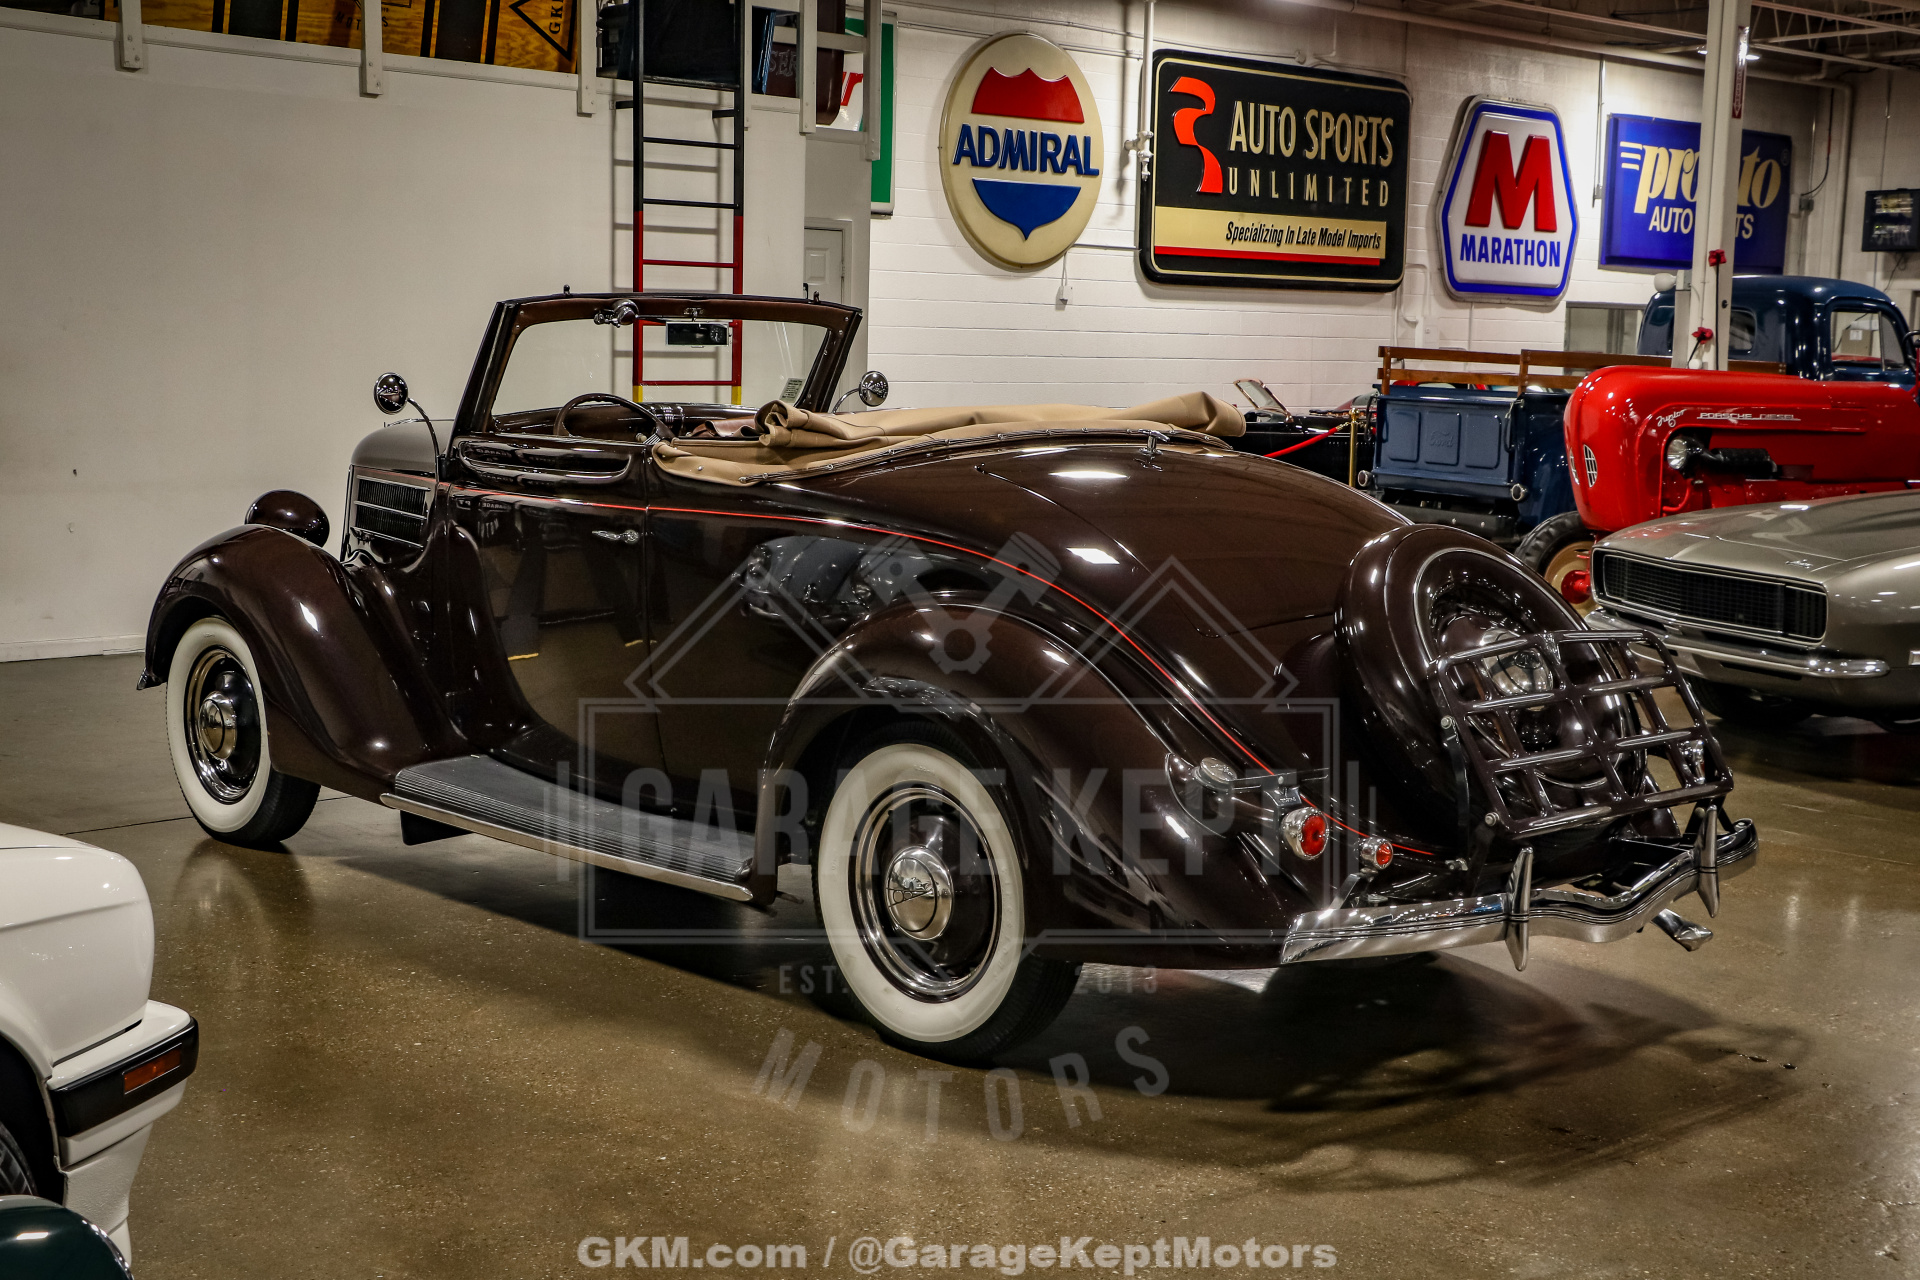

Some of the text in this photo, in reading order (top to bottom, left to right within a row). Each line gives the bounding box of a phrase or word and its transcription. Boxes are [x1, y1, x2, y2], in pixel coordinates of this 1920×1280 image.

[336, 11, 389, 31] MOTS
[953, 123, 1100, 176] ADMIRAL
[1229, 101, 1394, 167] AUTO SPORTS
[1228, 166, 1389, 207] UNLIMITED
[1465, 130, 1558, 233] M
[1634, 144, 1782, 214] proto
[1226, 220, 1381, 251] Specializing In Late Model Imports
[1648, 205, 1694, 235] AUTO
[1460, 233, 1561, 268] MARATHON
[1656, 408, 1687, 427] Junior
[1700, 412, 1752, 420] PORSCHE
